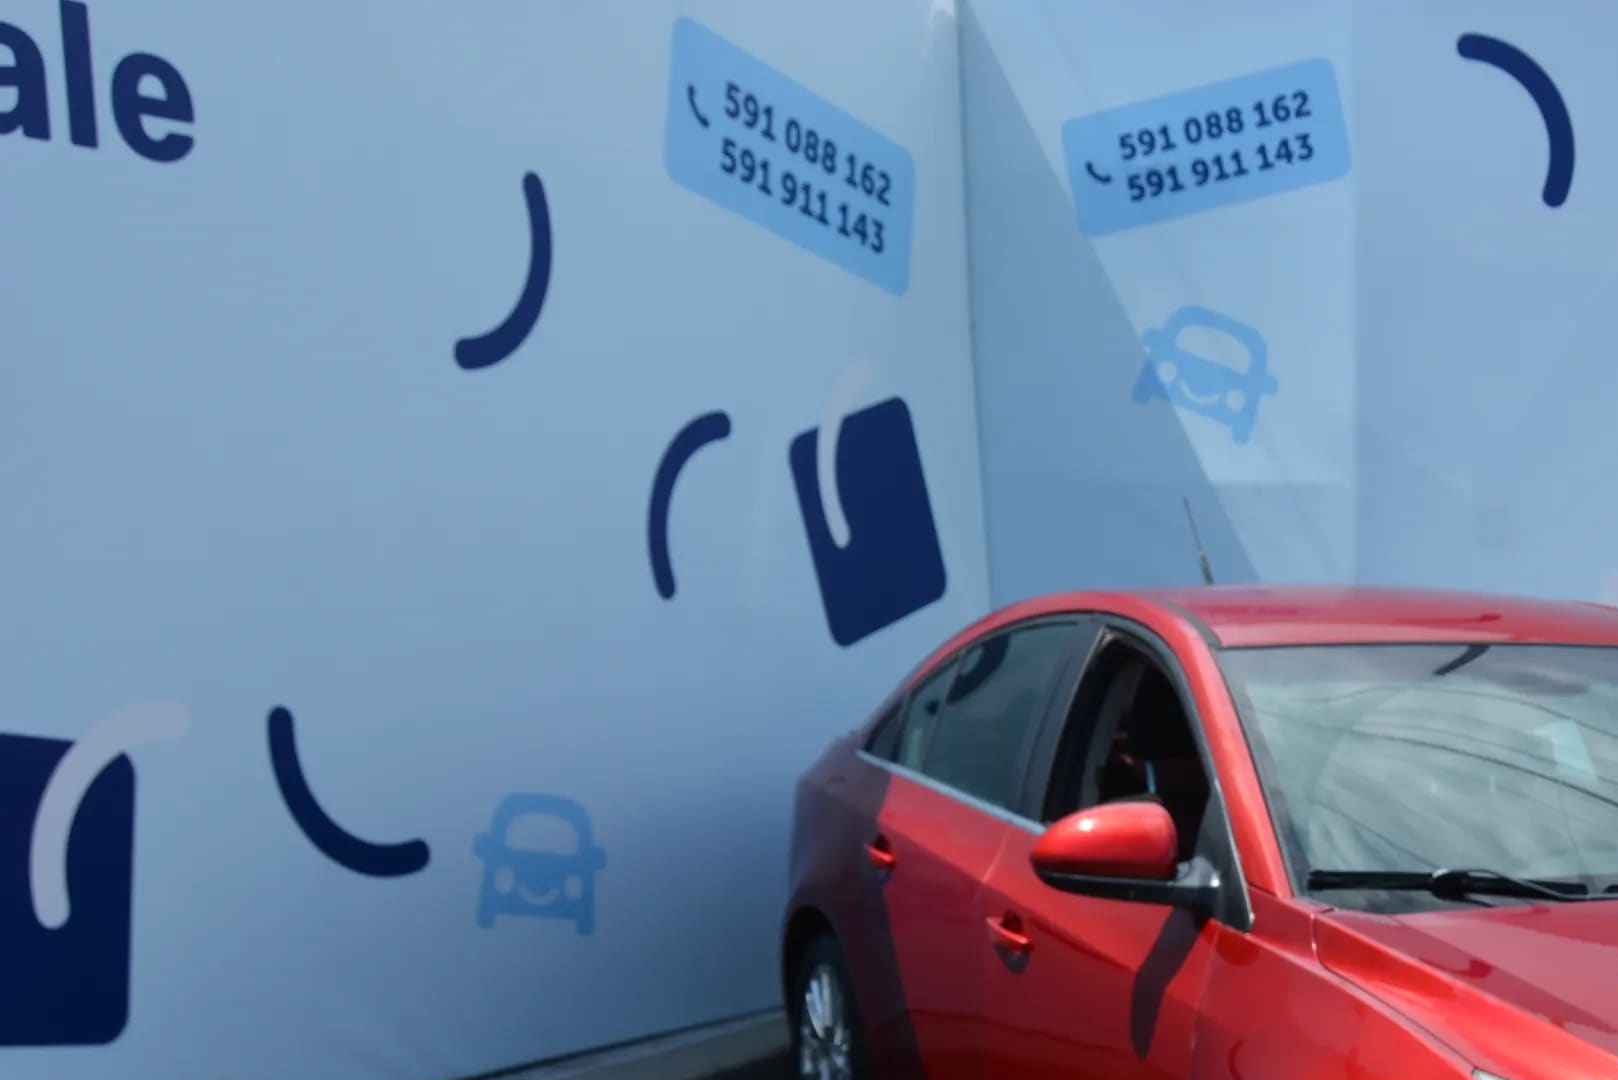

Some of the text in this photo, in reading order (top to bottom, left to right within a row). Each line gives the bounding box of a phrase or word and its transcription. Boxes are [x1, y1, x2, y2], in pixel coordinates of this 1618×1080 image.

[724, 80, 892, 208] 591 088 162
[1118, 89, 1313, 161] 591 088 162
[1127, 132, 1315, 202] 591 911 143
[720, 136, 886, 254] 591 911 143
